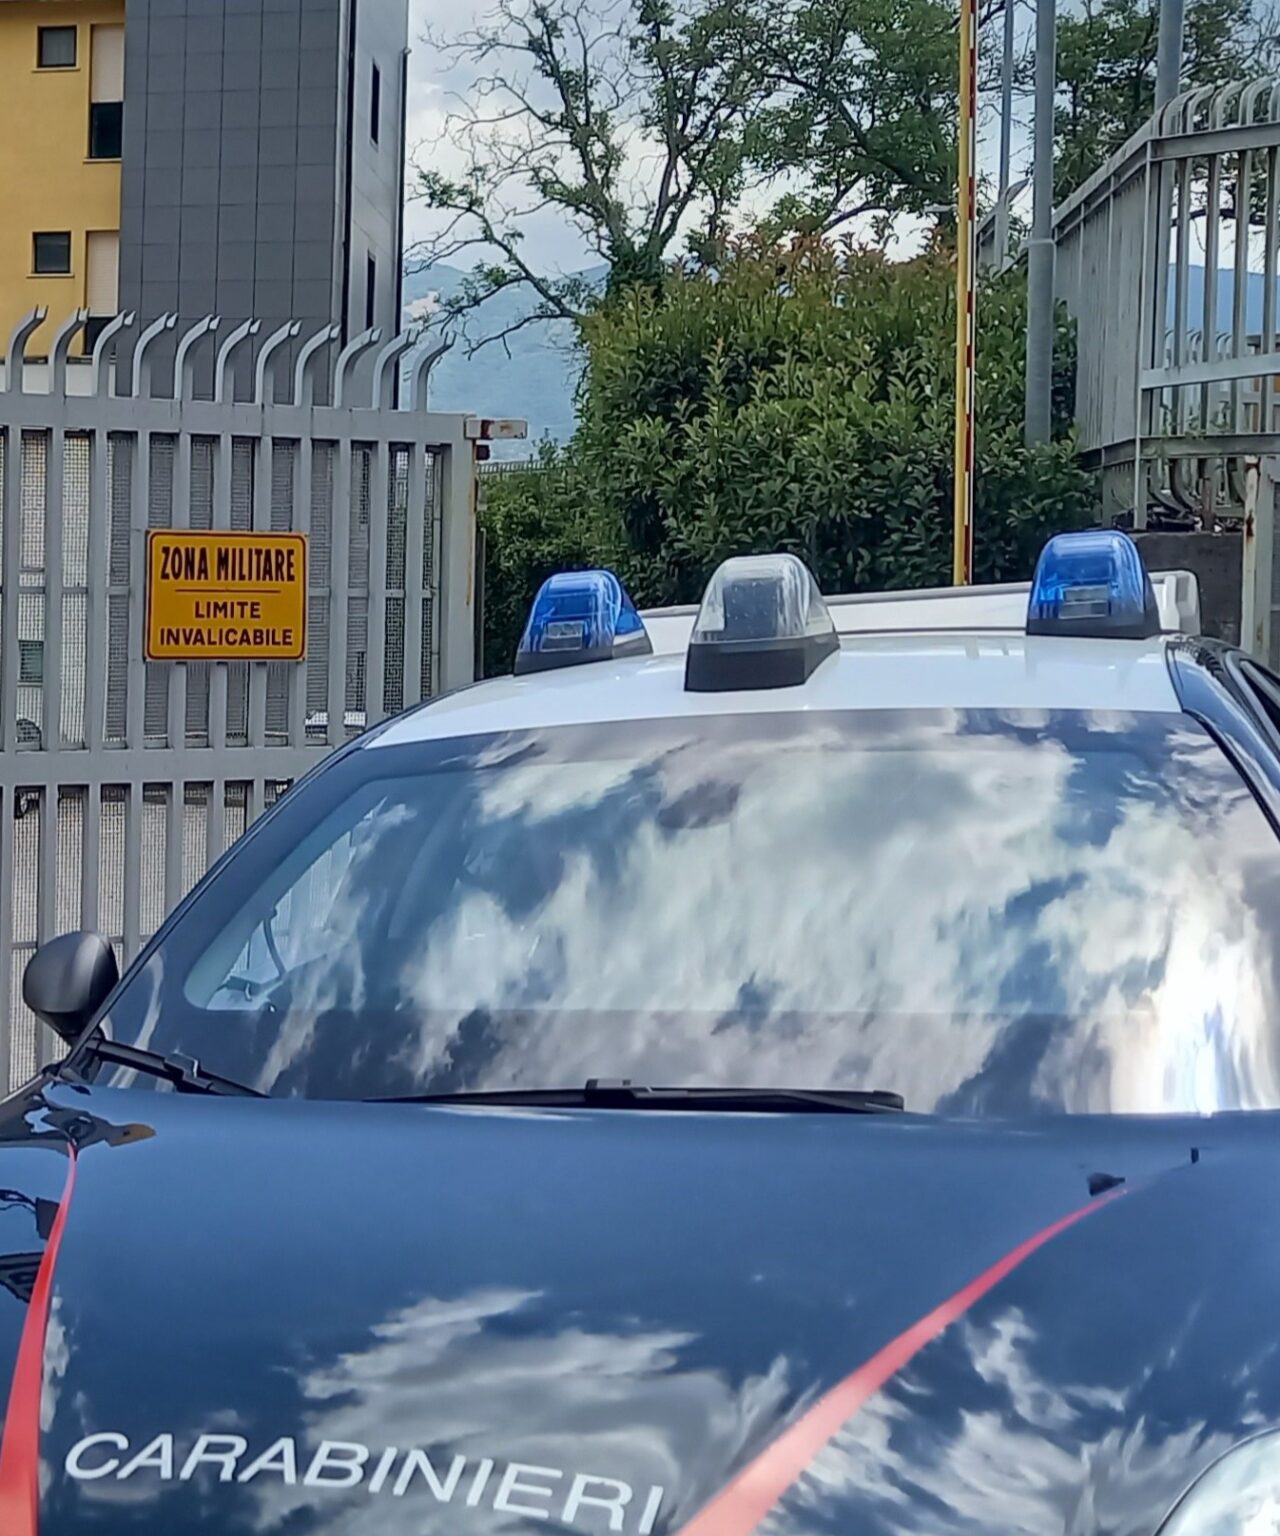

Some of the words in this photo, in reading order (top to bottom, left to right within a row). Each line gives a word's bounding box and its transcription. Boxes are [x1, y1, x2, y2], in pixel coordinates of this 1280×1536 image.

[160, 546, 209, 580] ZONA
[216, 547, 295, 582] MILITARE
[194, 601, 261, 619] LIMITE
[160, 628, 293, 646] INVALICABILE
[64, 1431, 664, 1535] CARABINIERI
